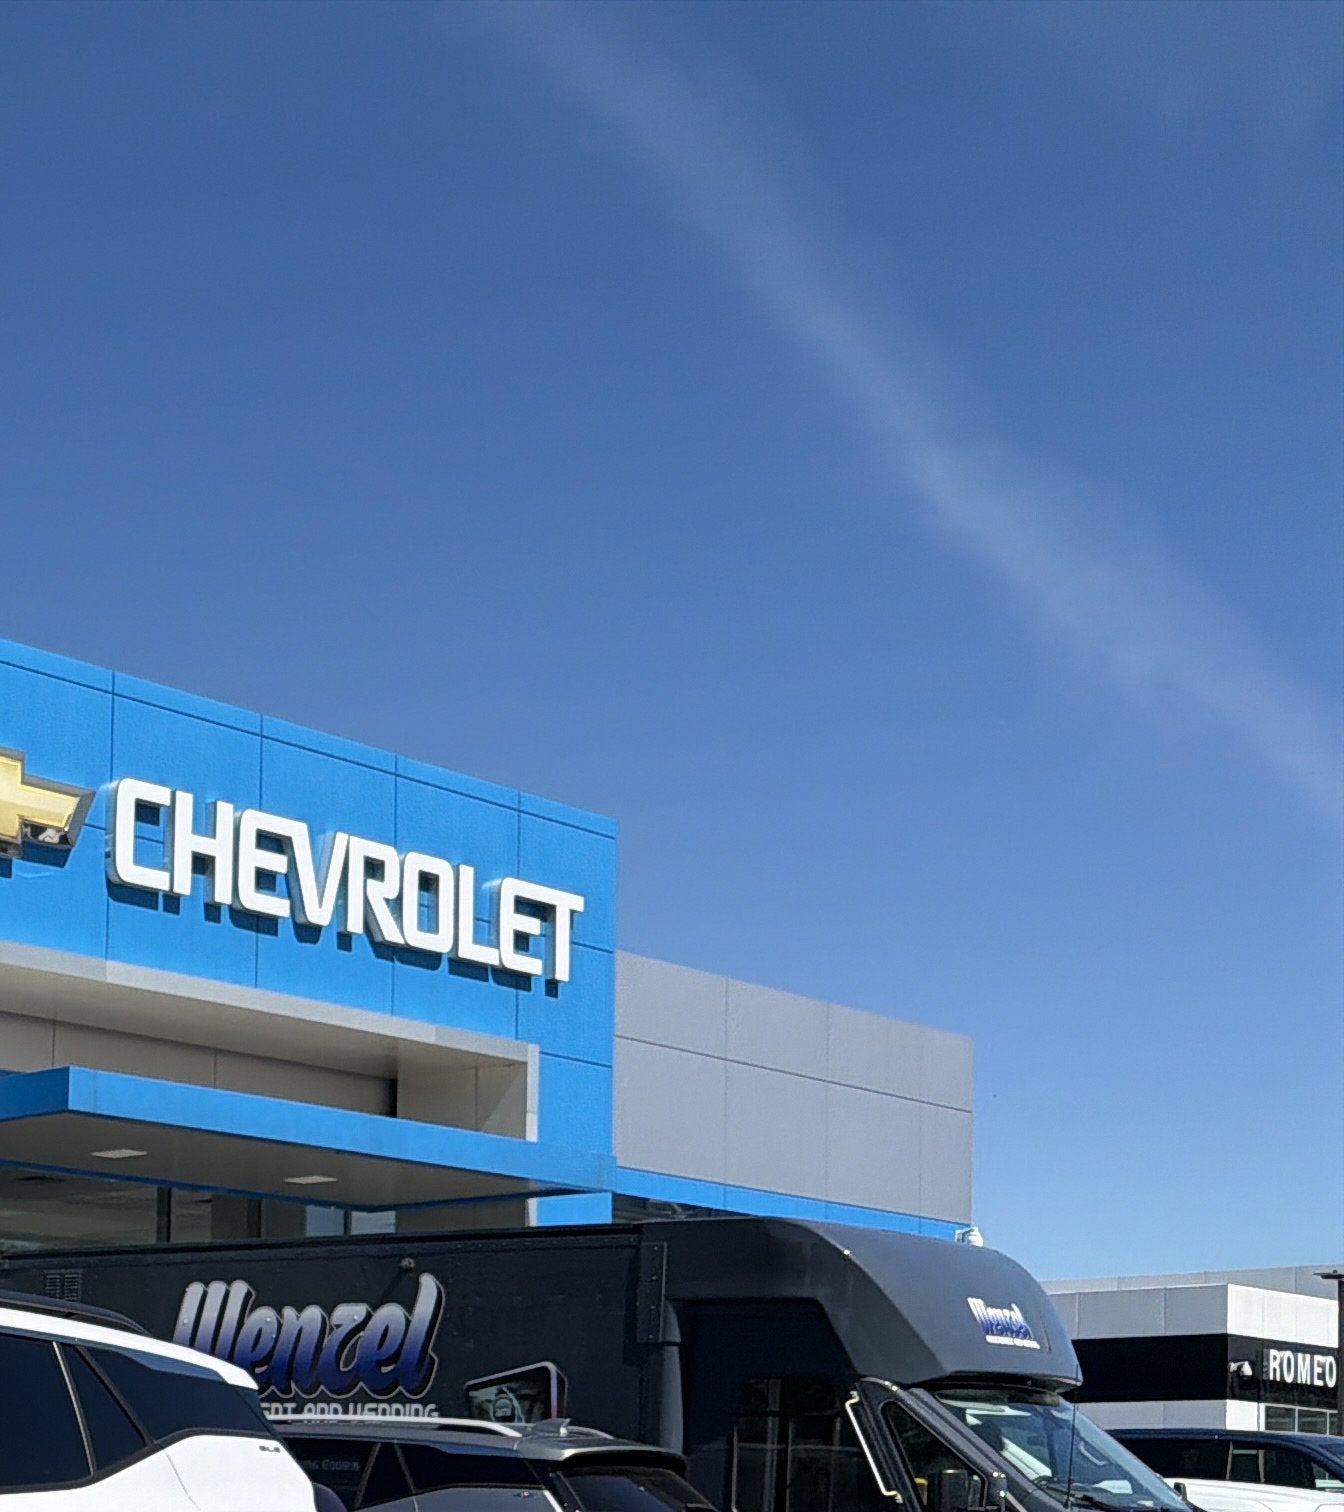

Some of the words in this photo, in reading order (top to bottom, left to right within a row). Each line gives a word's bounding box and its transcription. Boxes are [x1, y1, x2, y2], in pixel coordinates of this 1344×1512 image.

[109, 778, 585, 982] CHEVROLET
[174, 1272, 445, 1398] Wenzel
[1269, 1349, 1337, 1388] ROMEO
